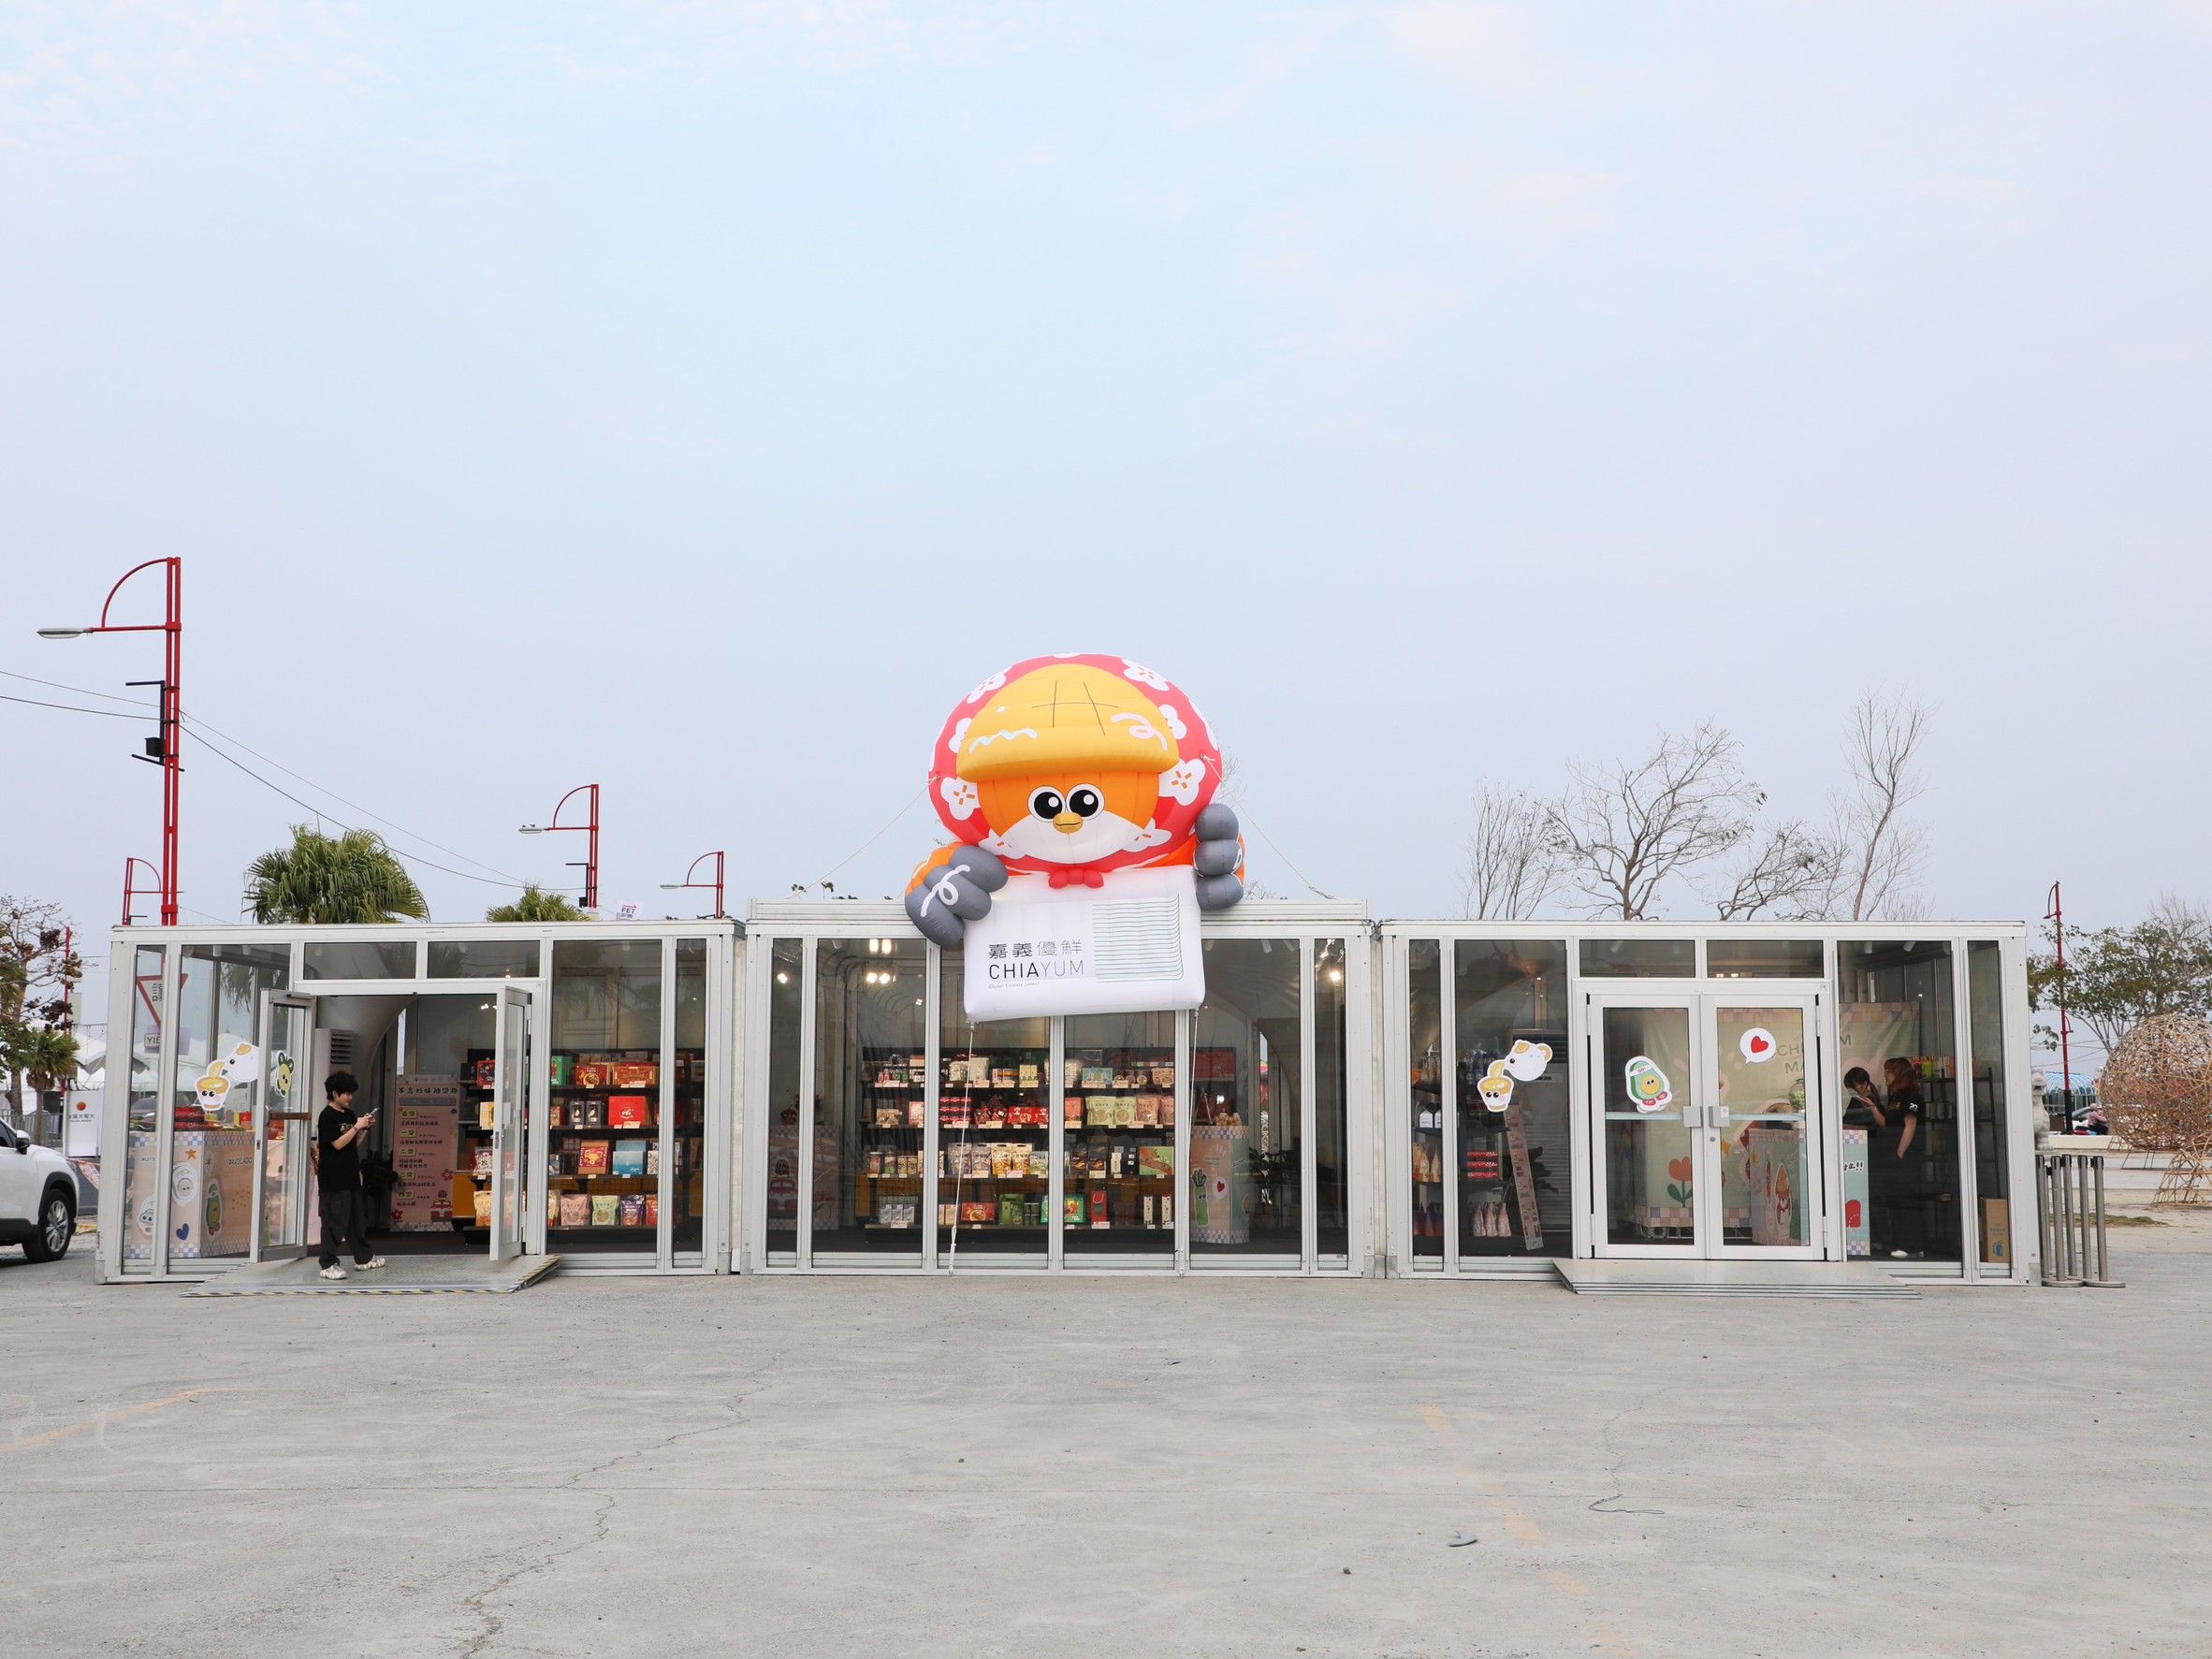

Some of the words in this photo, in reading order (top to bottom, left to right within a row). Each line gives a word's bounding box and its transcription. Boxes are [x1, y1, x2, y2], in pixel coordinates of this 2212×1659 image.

[988, 939, 1083, 959] 嘉義優鮮
[989, 959, 1084, 980] CHIAYUM
